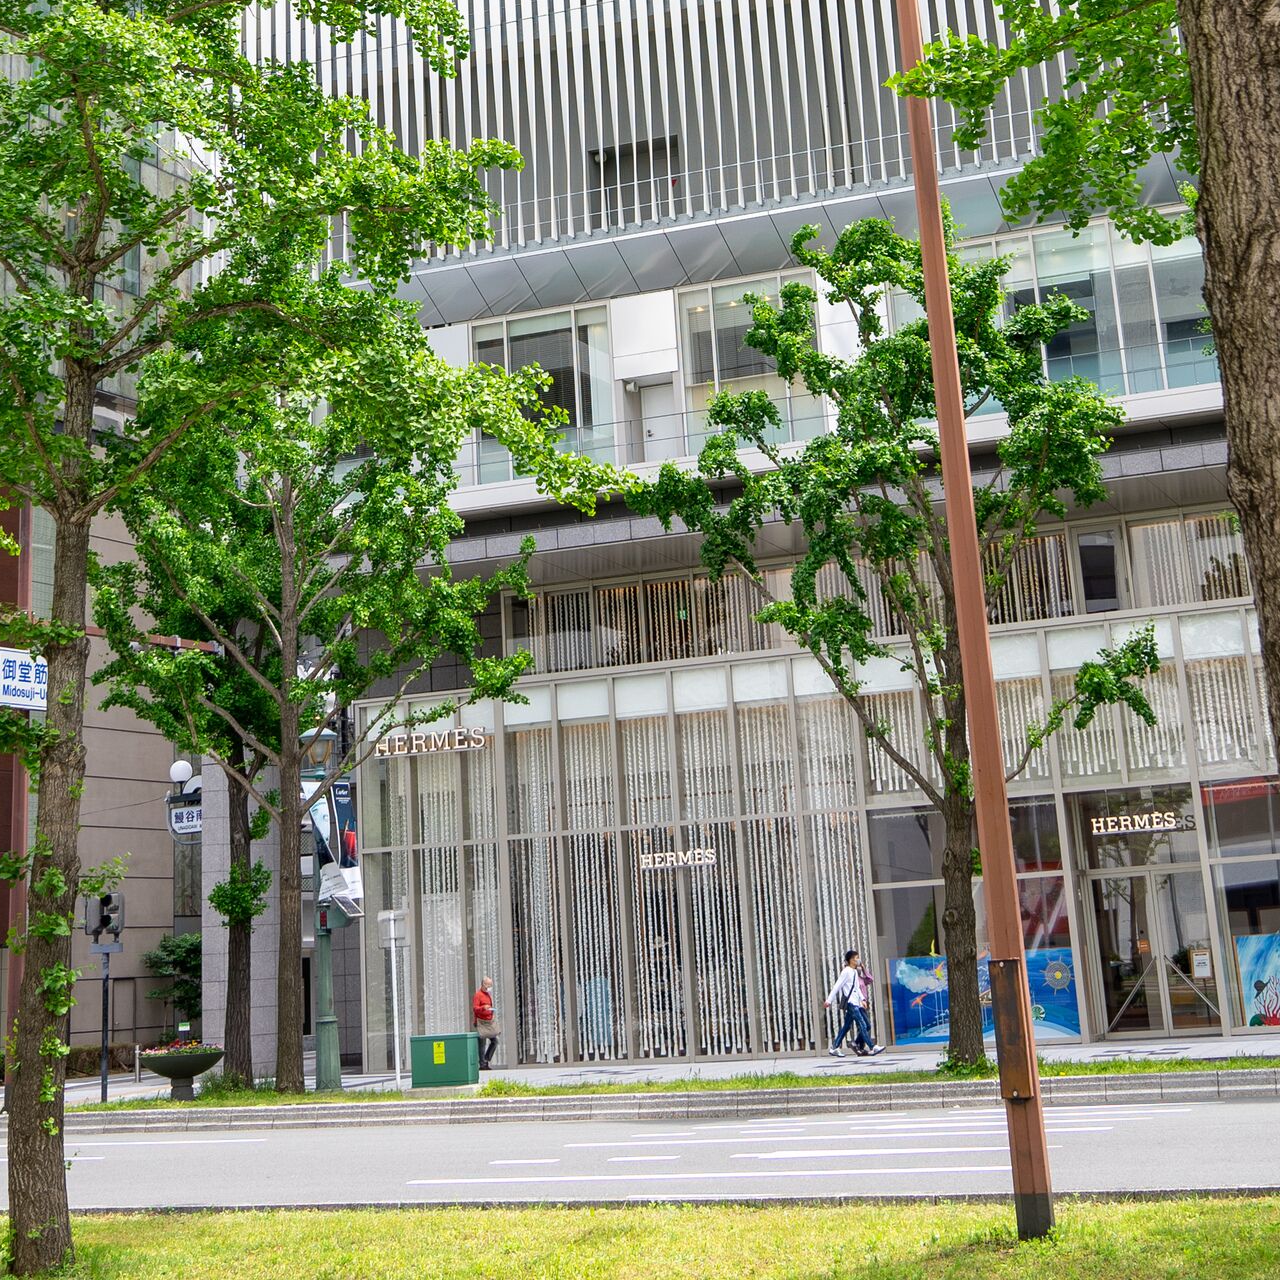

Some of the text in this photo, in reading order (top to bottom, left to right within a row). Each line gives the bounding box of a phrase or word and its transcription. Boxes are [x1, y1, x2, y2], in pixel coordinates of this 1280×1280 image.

[2, 658, 48, 685] 御堂筋
[2, 684, 48, 701] Midosuji-U
